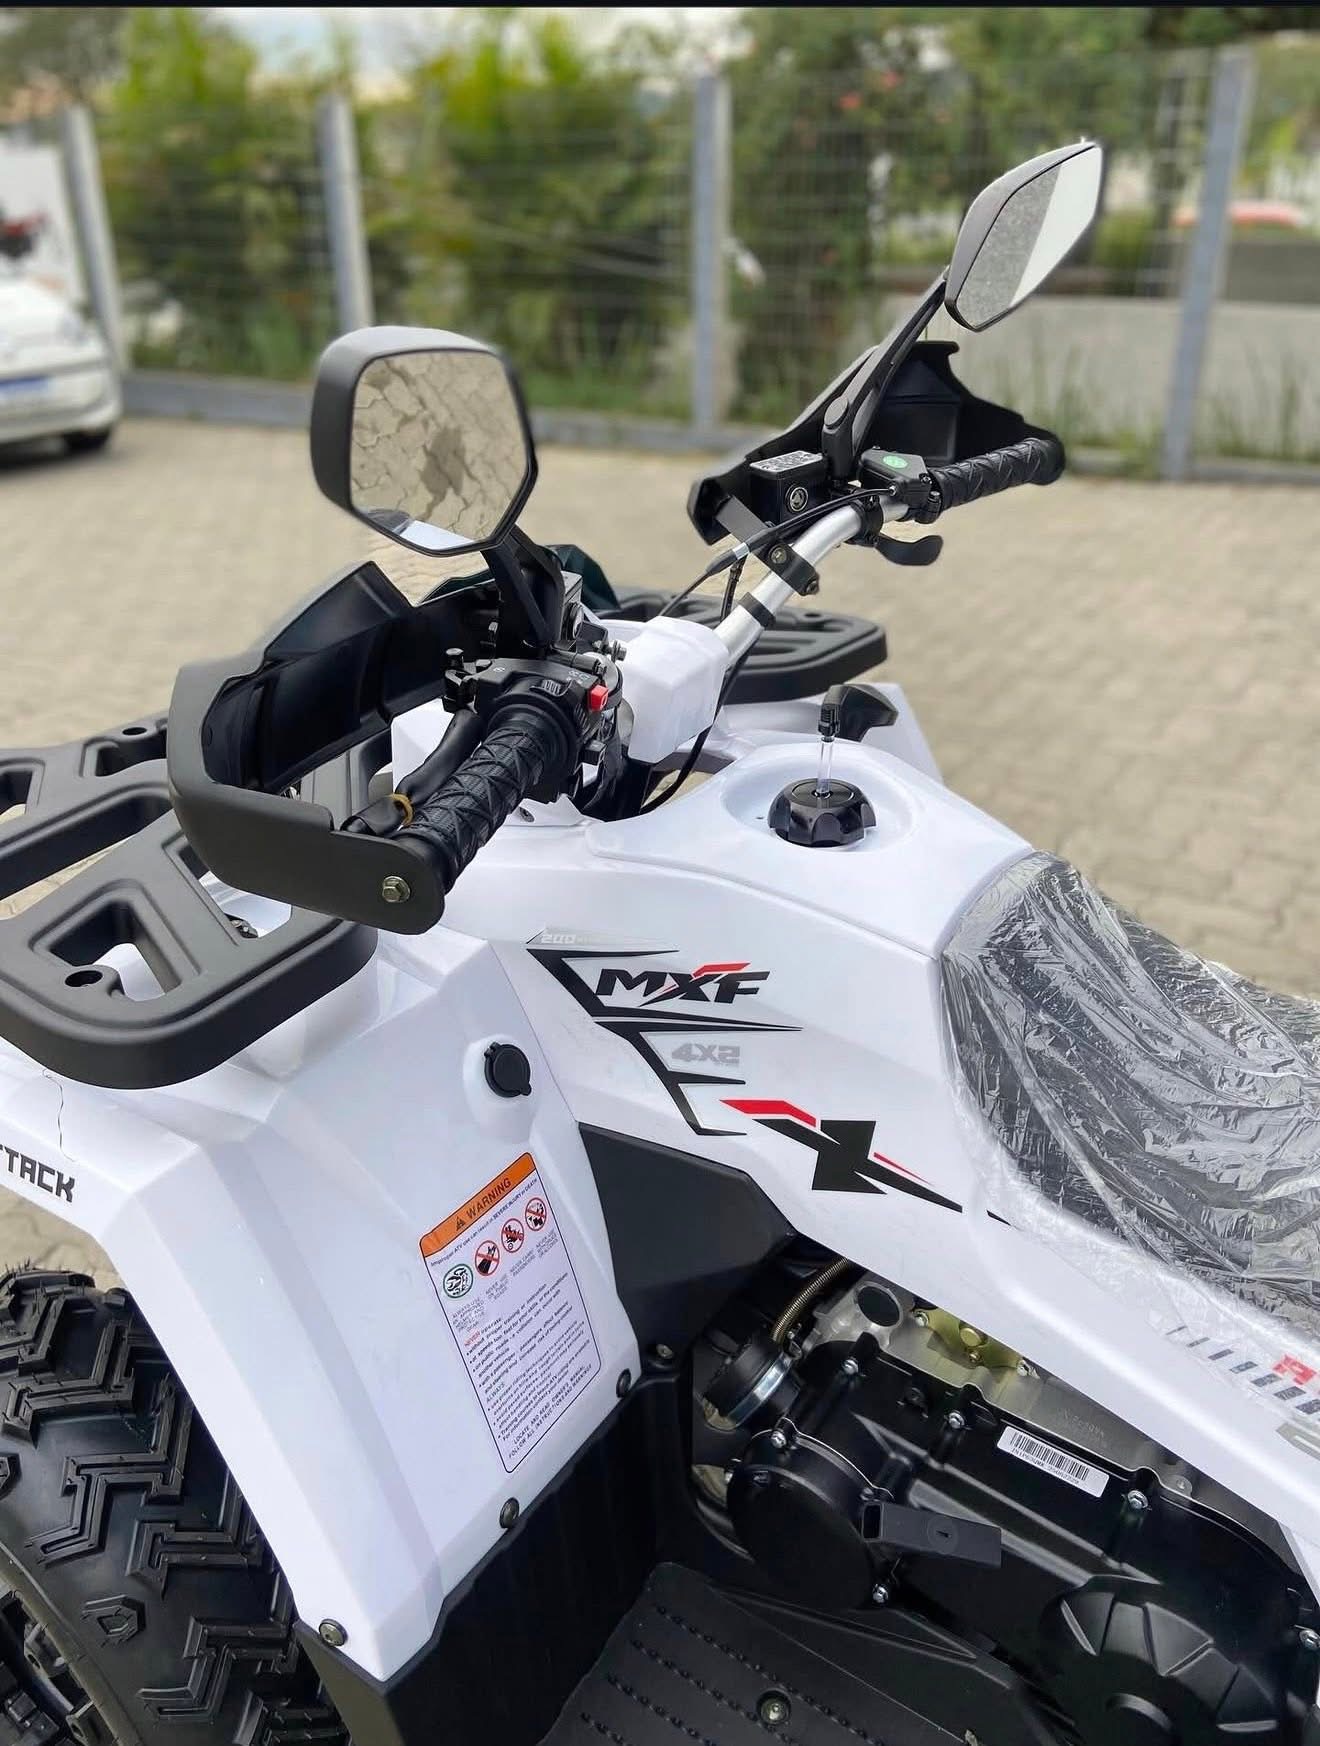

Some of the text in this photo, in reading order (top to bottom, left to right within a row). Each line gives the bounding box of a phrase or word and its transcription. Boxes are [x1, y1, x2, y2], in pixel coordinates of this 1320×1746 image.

[595, 962, 770, 1007] MXF
[671, 1042, 741, 1064] 4X2
[0, 1144, 75, 1203] TACK
[467, 1176, 511, 1219] WARNING
